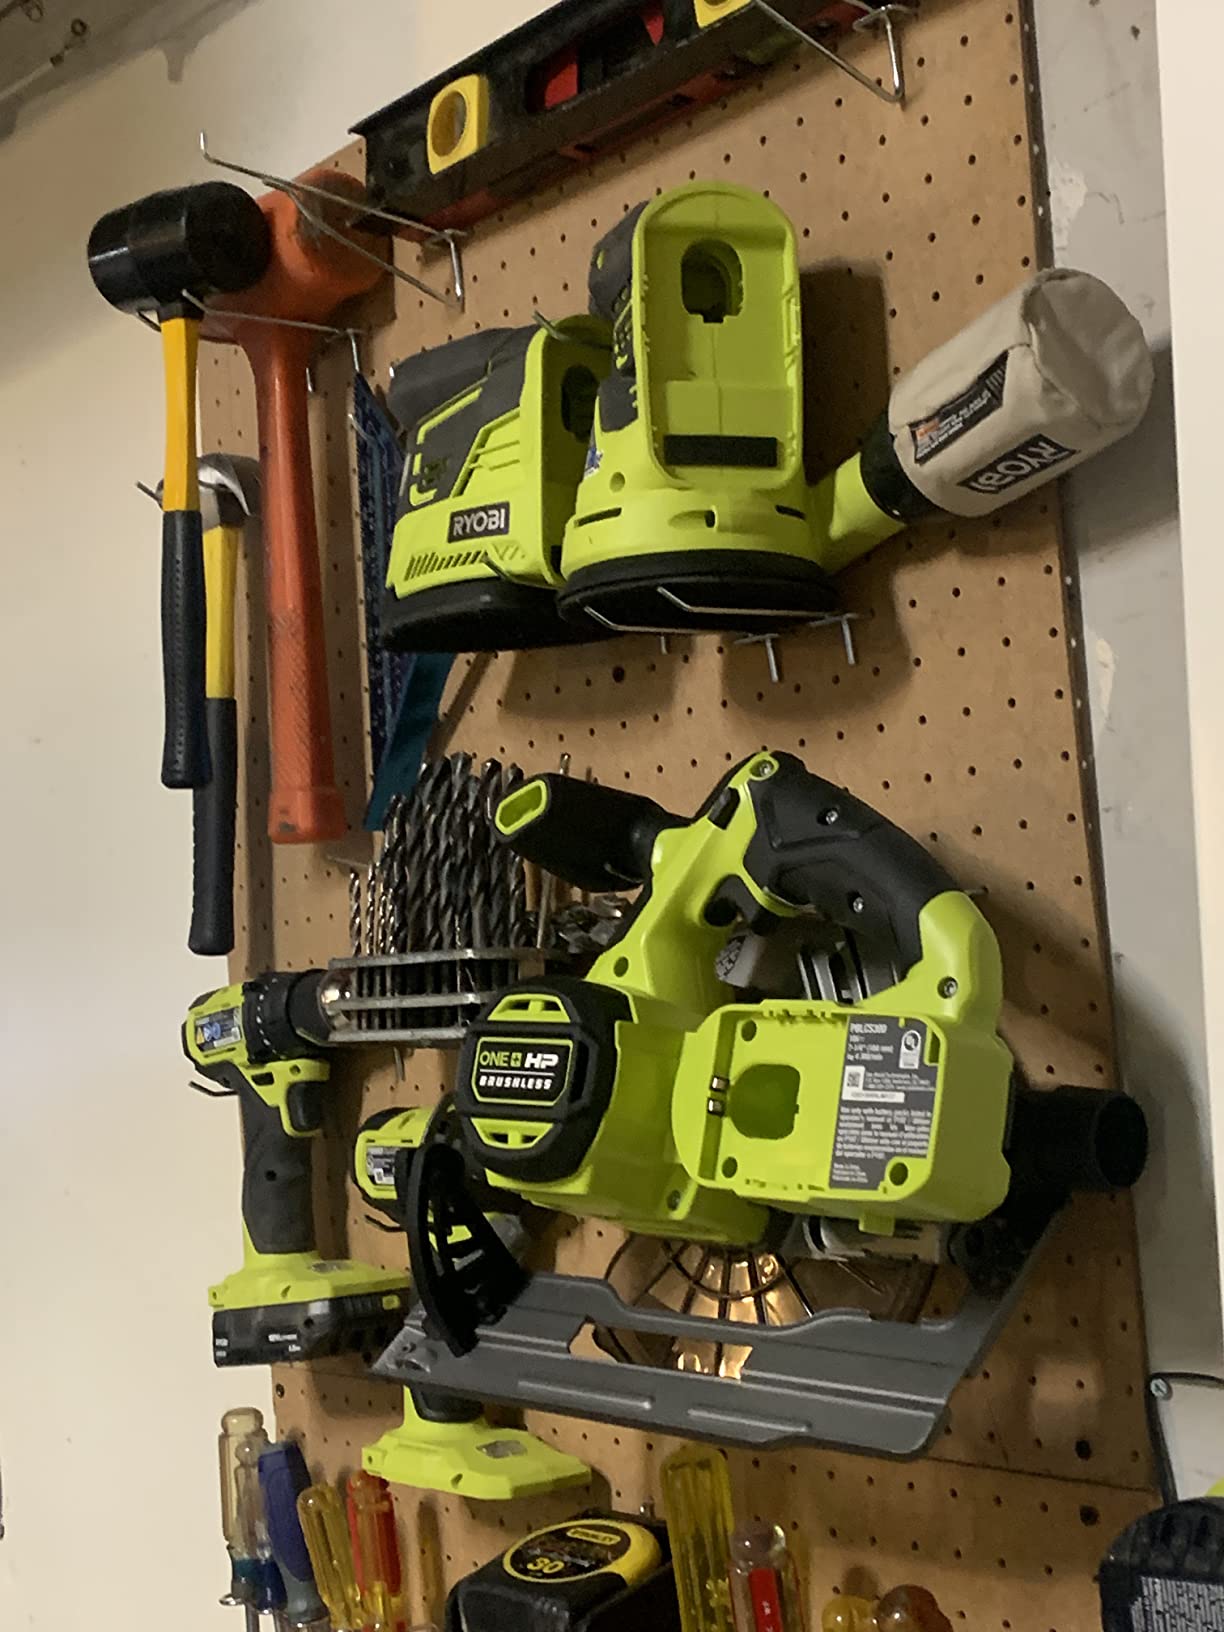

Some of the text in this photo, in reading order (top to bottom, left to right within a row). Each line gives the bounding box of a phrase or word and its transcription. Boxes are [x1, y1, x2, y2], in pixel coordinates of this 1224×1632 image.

[969, 441, 1069, 490] RYOBI
[453, 508, 506, 536] RYOBI
[524, 1052, 559, 1069] HP
[479, 1075, 553, 1090] BRUSHLESS
[526, 1557, 565, 1574] 30
